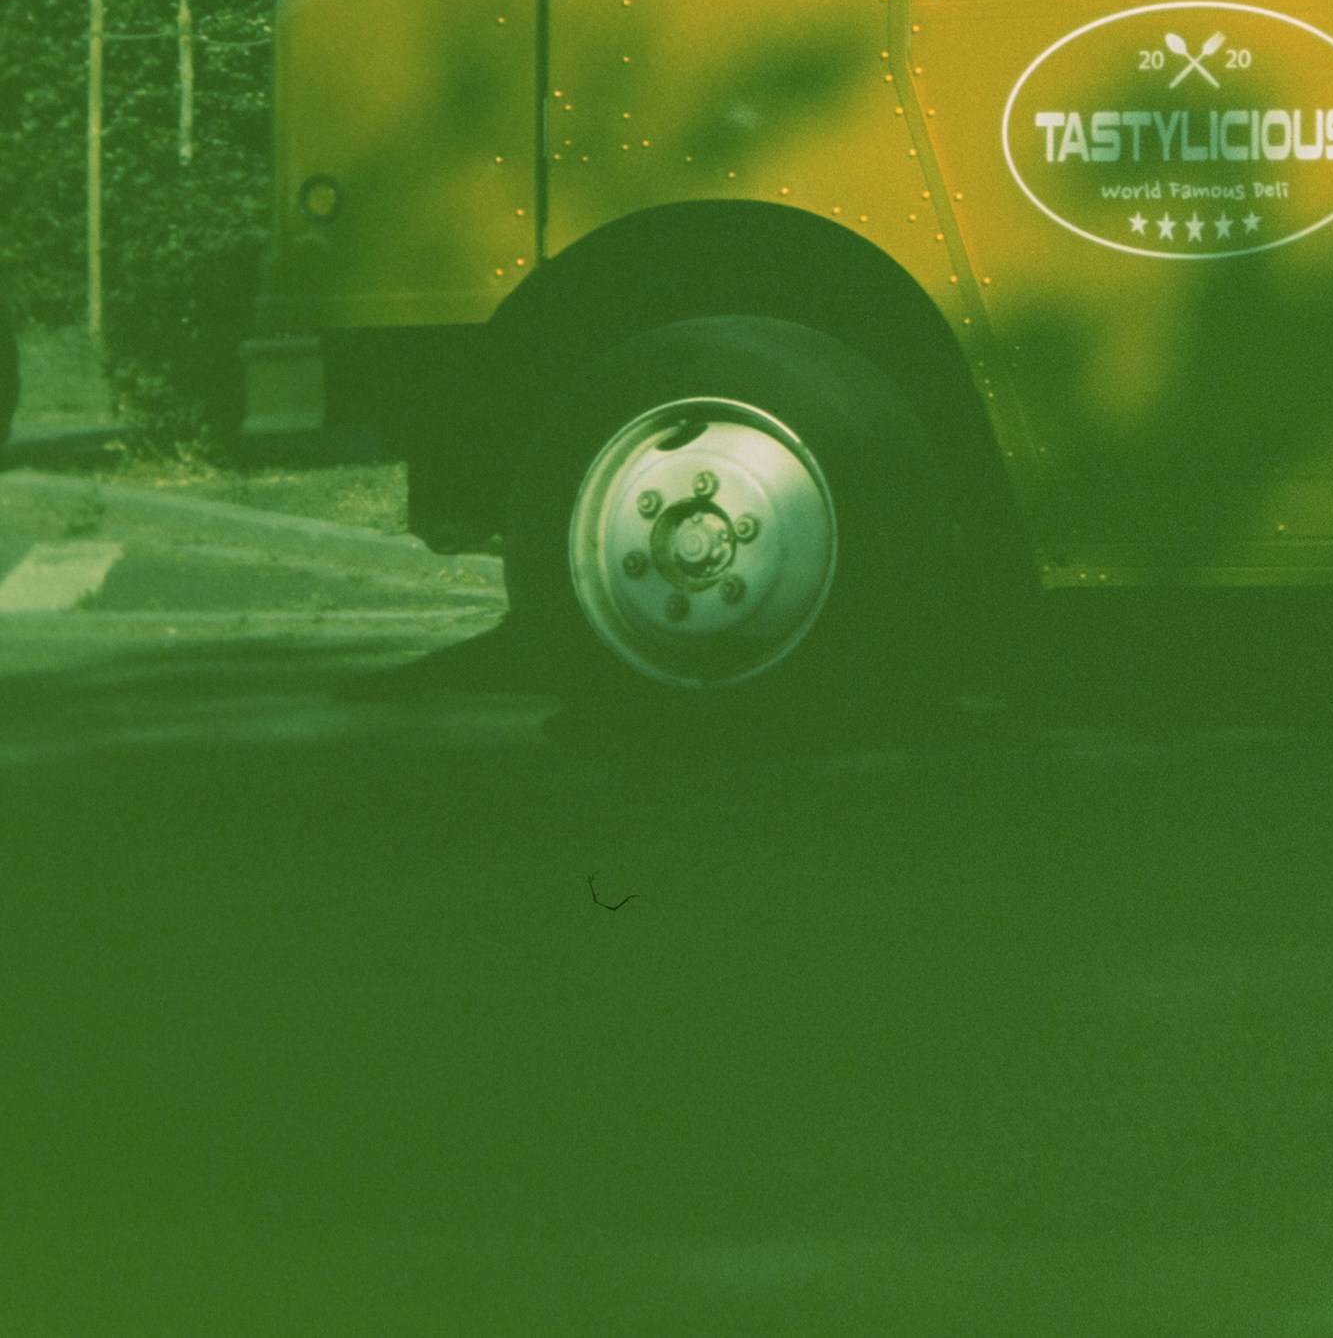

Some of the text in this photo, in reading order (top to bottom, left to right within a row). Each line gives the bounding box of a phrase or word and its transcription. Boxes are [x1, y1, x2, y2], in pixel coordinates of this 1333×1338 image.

[1139, 49, 1252, 70] 20 20
[1169, 182, 1245, 201] Famous
[1253, 181, 1289, 199] Deli
